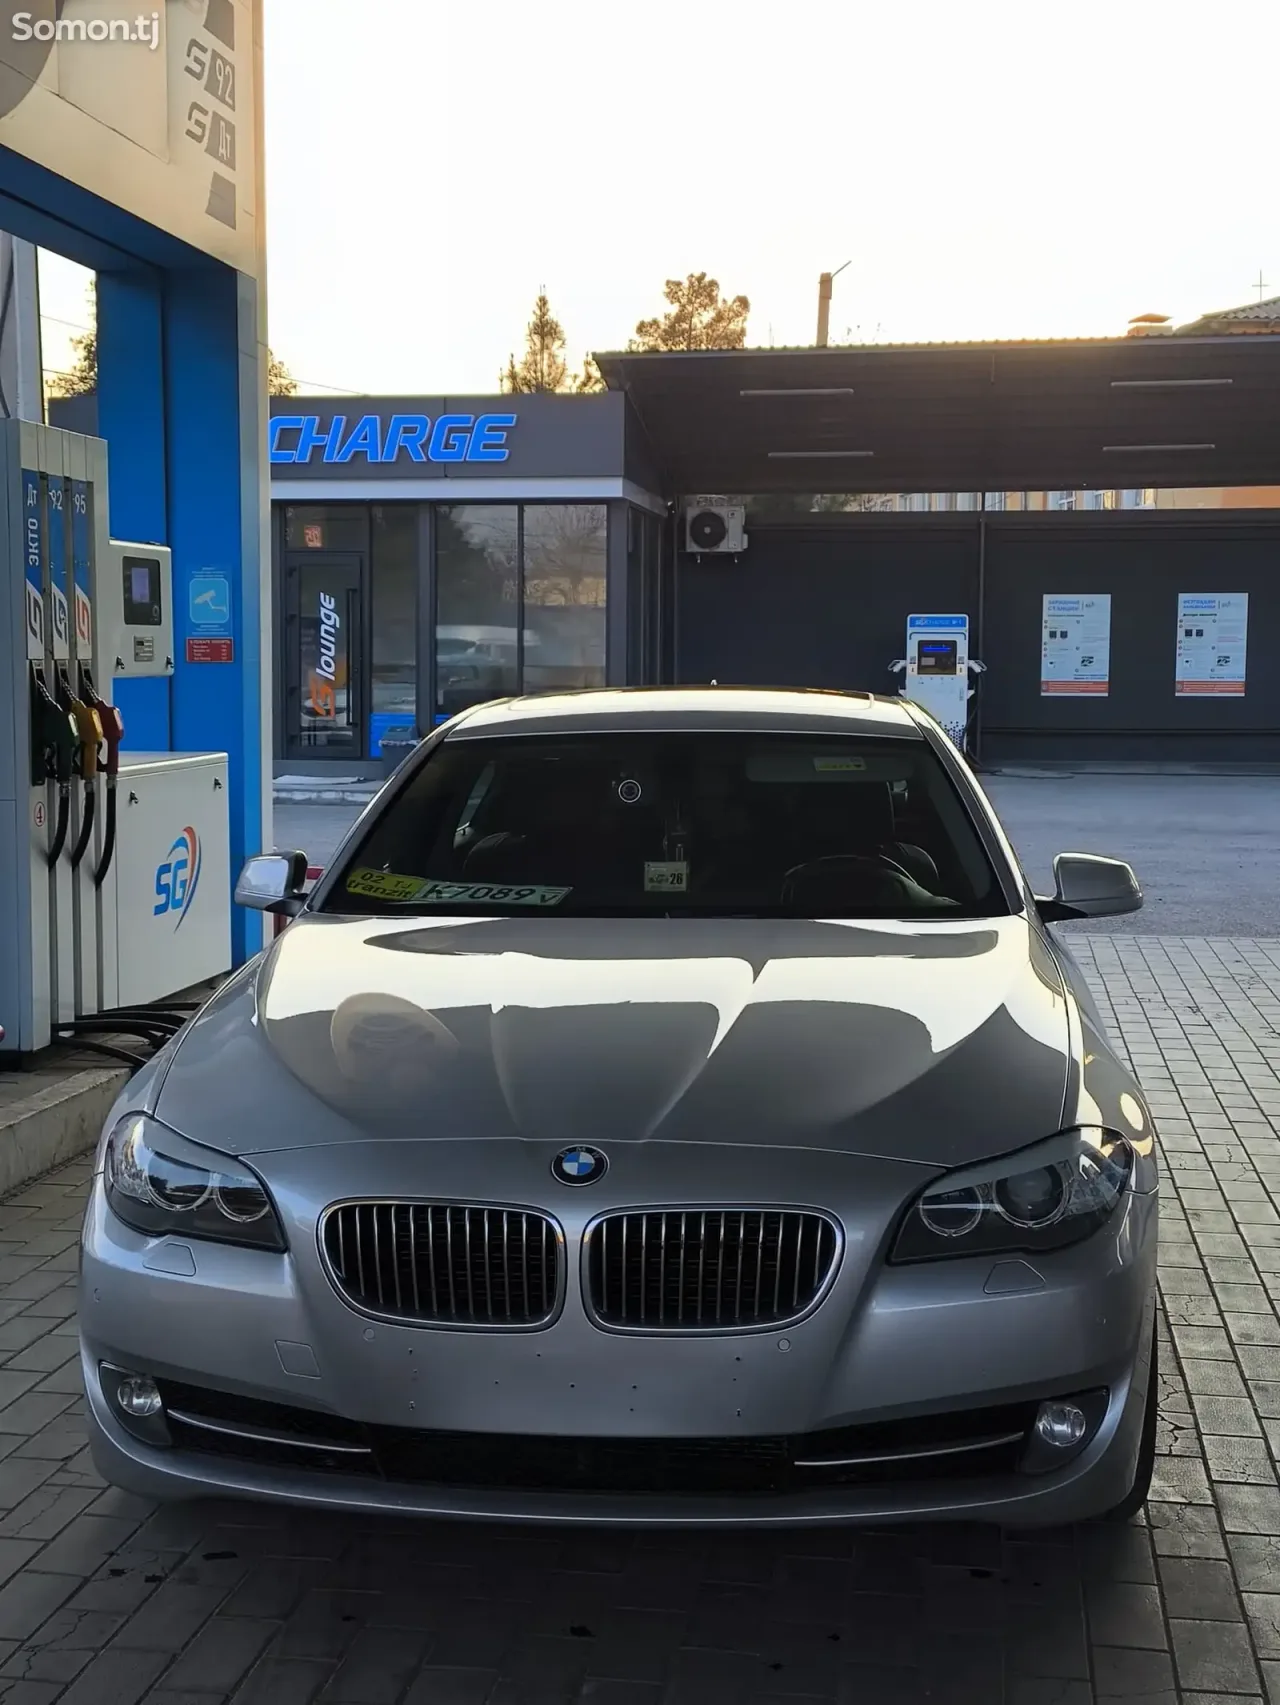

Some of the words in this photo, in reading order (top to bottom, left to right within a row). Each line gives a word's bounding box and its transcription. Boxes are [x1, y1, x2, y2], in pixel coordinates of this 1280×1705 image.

[216, 58, 234, 106] 92
[269, 413, 517, 463] CHARGE
[50, 489, 63, 511] 92
[74, 493, 87, 514] 95
[28, 518, 39, 566] ЭКТО
[316, 591, 340, 681] lounge
[153, 858, 188, 916] SG
[347, 879, 413, 899] tranzit
[421, 884, 536, 901] K7089
[361, 872, 385, 884] 02
